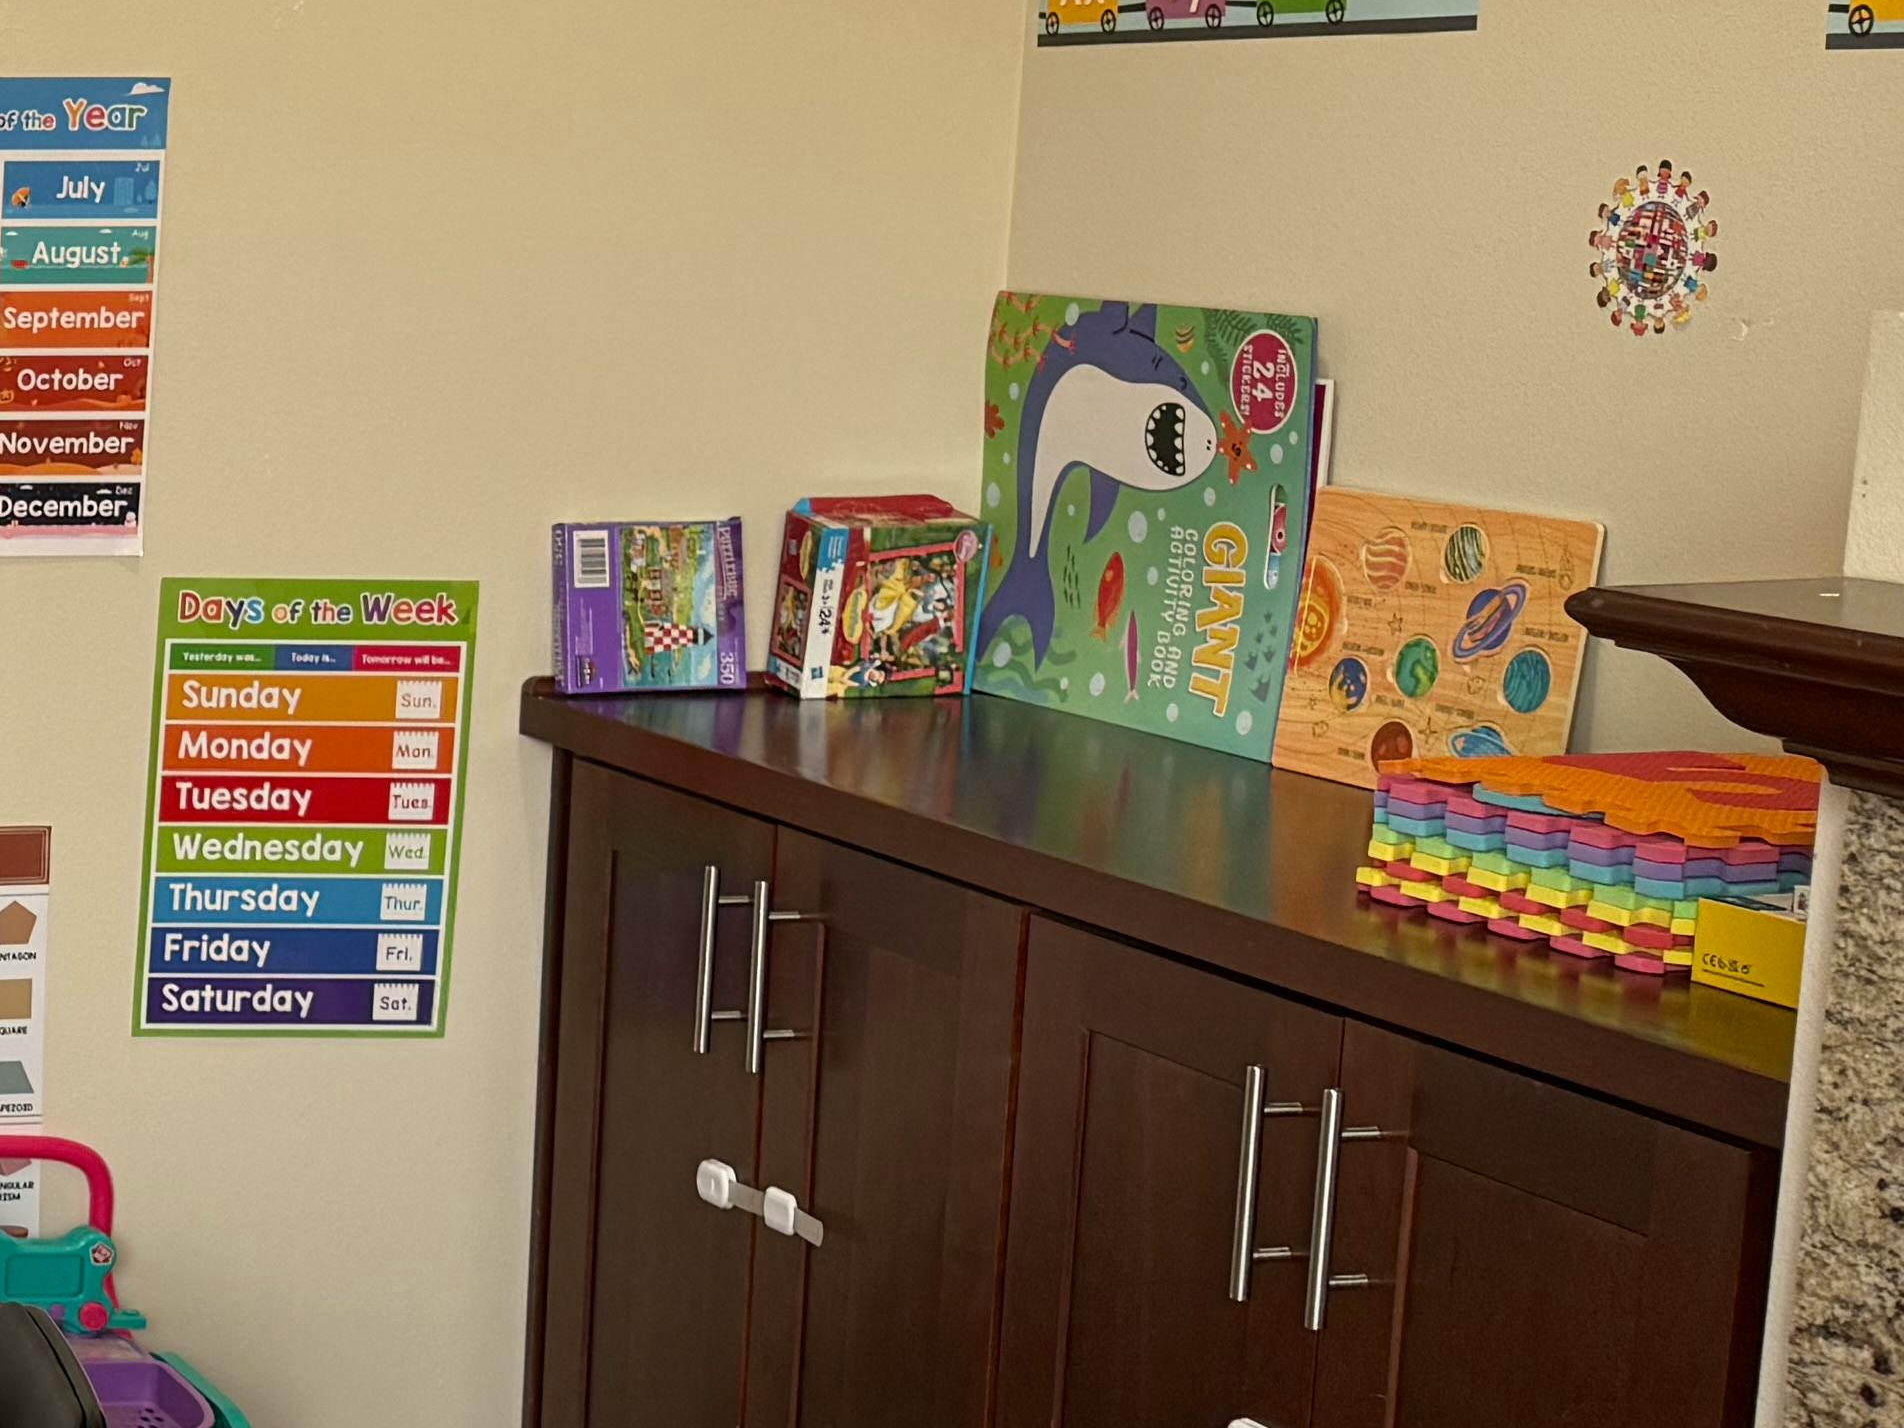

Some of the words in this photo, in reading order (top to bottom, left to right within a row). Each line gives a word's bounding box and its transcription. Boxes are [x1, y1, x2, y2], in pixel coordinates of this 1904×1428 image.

[22, 108, 56, 130] the
[63, 99, 147, 131] Year
[56, 176, 105, 203] July
[32, 241, 120, 268] August
[4, 306, 144, 333] September
[17, 369, 123, 392] October
[1252, 360, 1275, 402] 24
[1274, 349, 1285, 417] INCLUDES
[1161, 526, 1181, 643] ACTIVITY
[1173, 528, 1198, 636] COLORING
[178, 591, 264, 629] Days
[273, 601, 302, 624] of
[312, 600, 351, 623] the
[361, 592, 458, 625] Week
[1189, 521, 1249, 717] GIANT
[720, 652, 734, 685] 350
[1147, 632, 1170, 688] BOOK
[1163, 646, 1179, 689] AND
[182, 680, 301, 714] Sunday
[401, 693, 436, 709] Sun.
[178, 731, 312, 766] Monday
[175, 781, 312, 817] Tuesday
[173, 832, 363, 867] Wednesday
[389, 844, 426, 860] Wed.
[169, 883, 319, 917] Thursday
[384, 895, 423, 911] Thur.
[163, 933, 270, 967] Friday
[385, 947, 412, 961] Fri.
[162, 983, 313, 1018] Saturday
[380, 997, 411, 1011] Sat.
